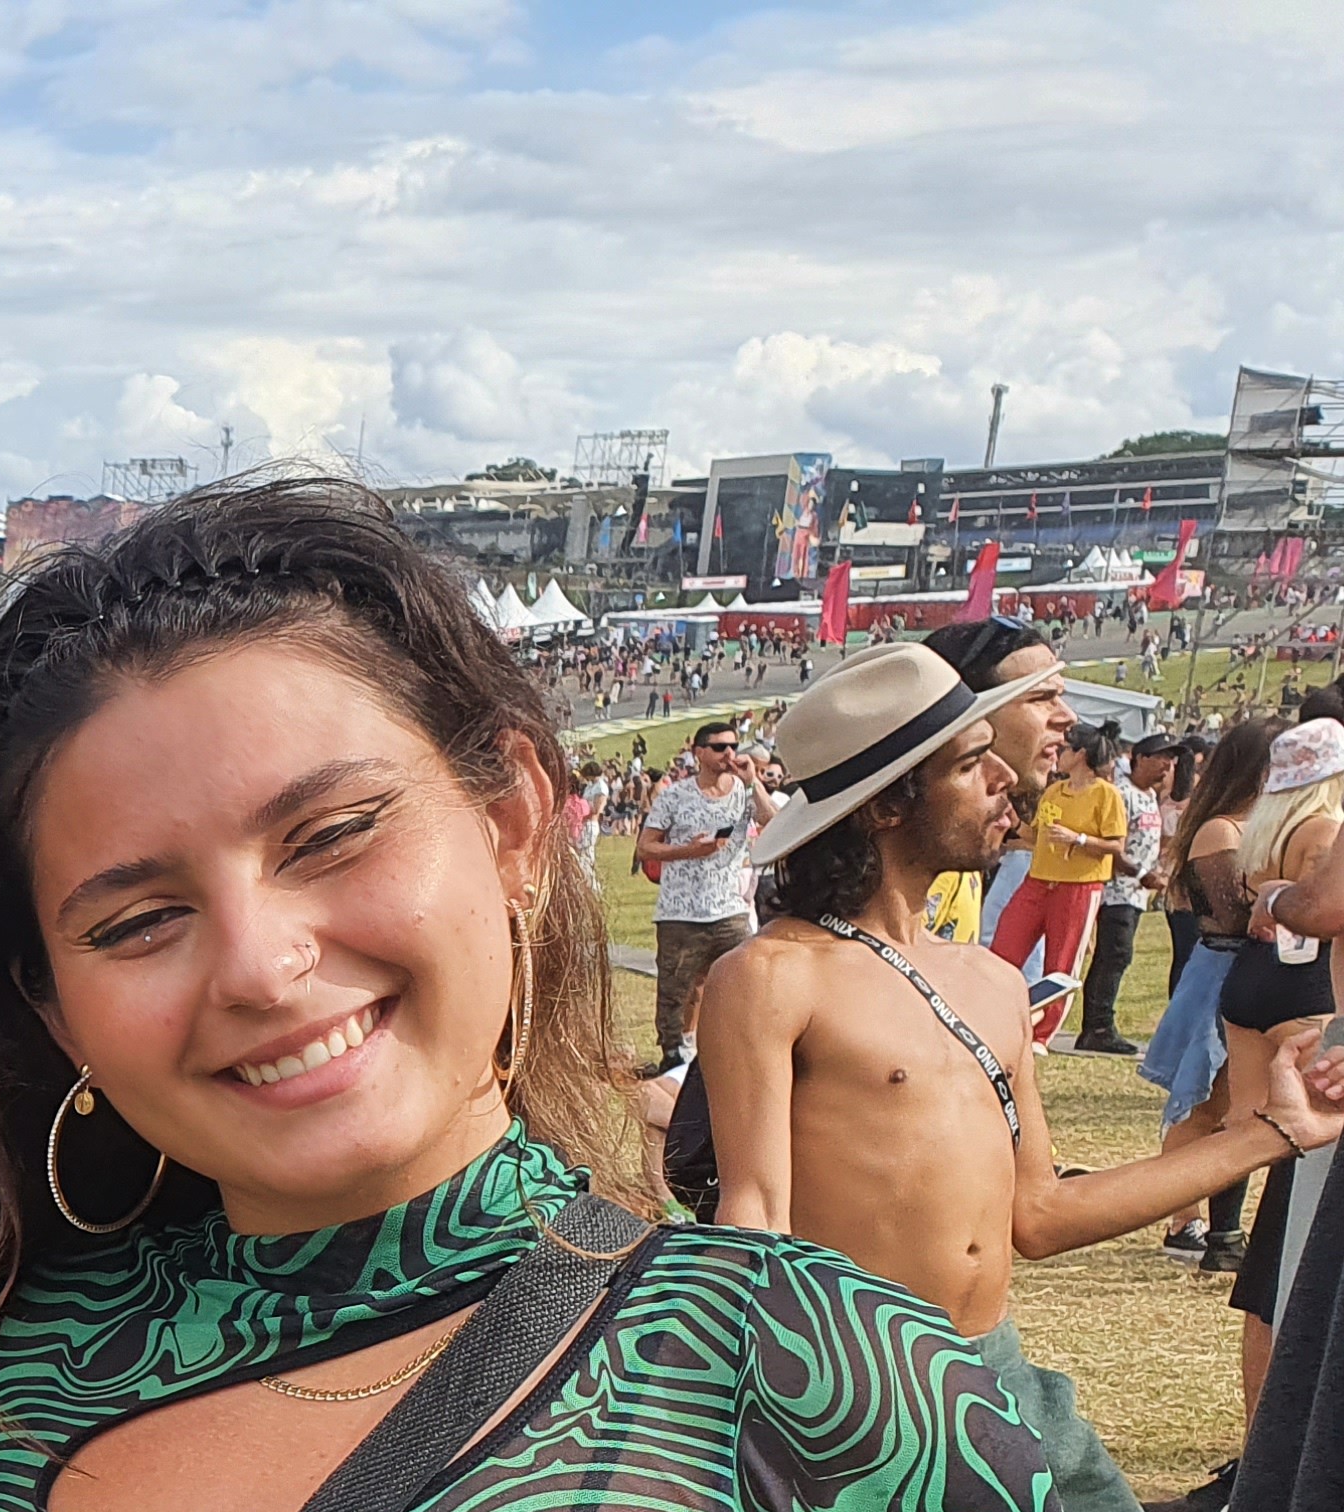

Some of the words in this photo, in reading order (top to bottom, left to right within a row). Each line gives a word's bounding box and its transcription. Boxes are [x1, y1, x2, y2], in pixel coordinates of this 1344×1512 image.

[819, 913, 858, 938] ONIX
[880, 946, 915, 977] ONIX
[930, 994, 961, 1029] ONIX
[975, 1045, 1002, 1082] ONIX
[1004, 1100, 1020, 1136] ONIX
